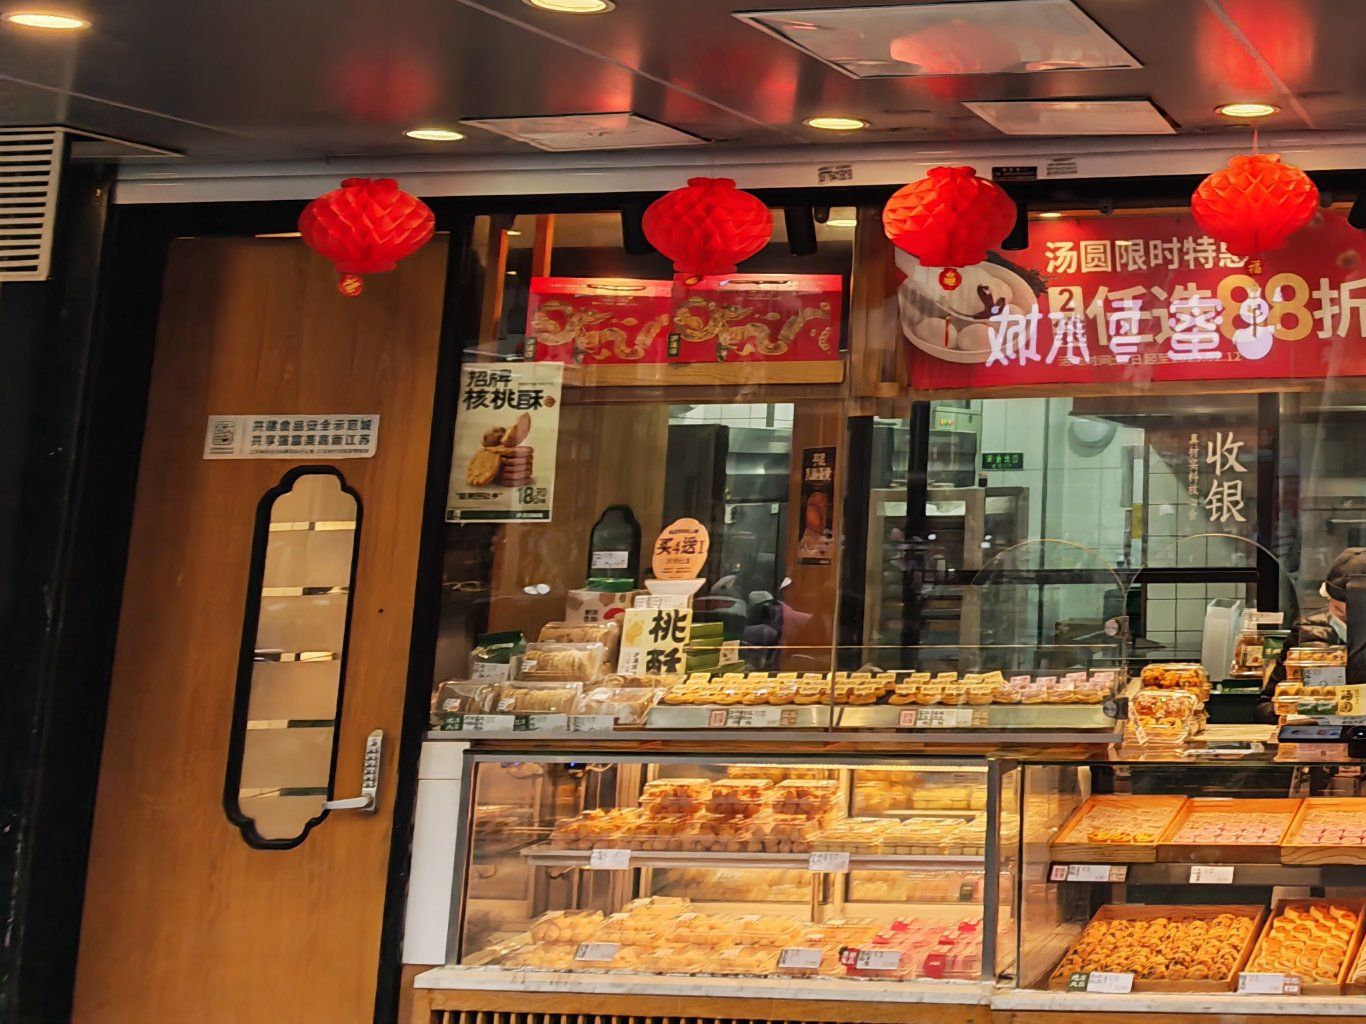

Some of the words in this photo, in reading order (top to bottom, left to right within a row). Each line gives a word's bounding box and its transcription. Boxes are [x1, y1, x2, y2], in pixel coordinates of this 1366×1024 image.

[463, 388, 544, 410] 核桃酥
[466, 368, 512, 388] 招牌
[1204, 431, 1249, 523] 收银
[645, 609, 689, 674] 桃酥
